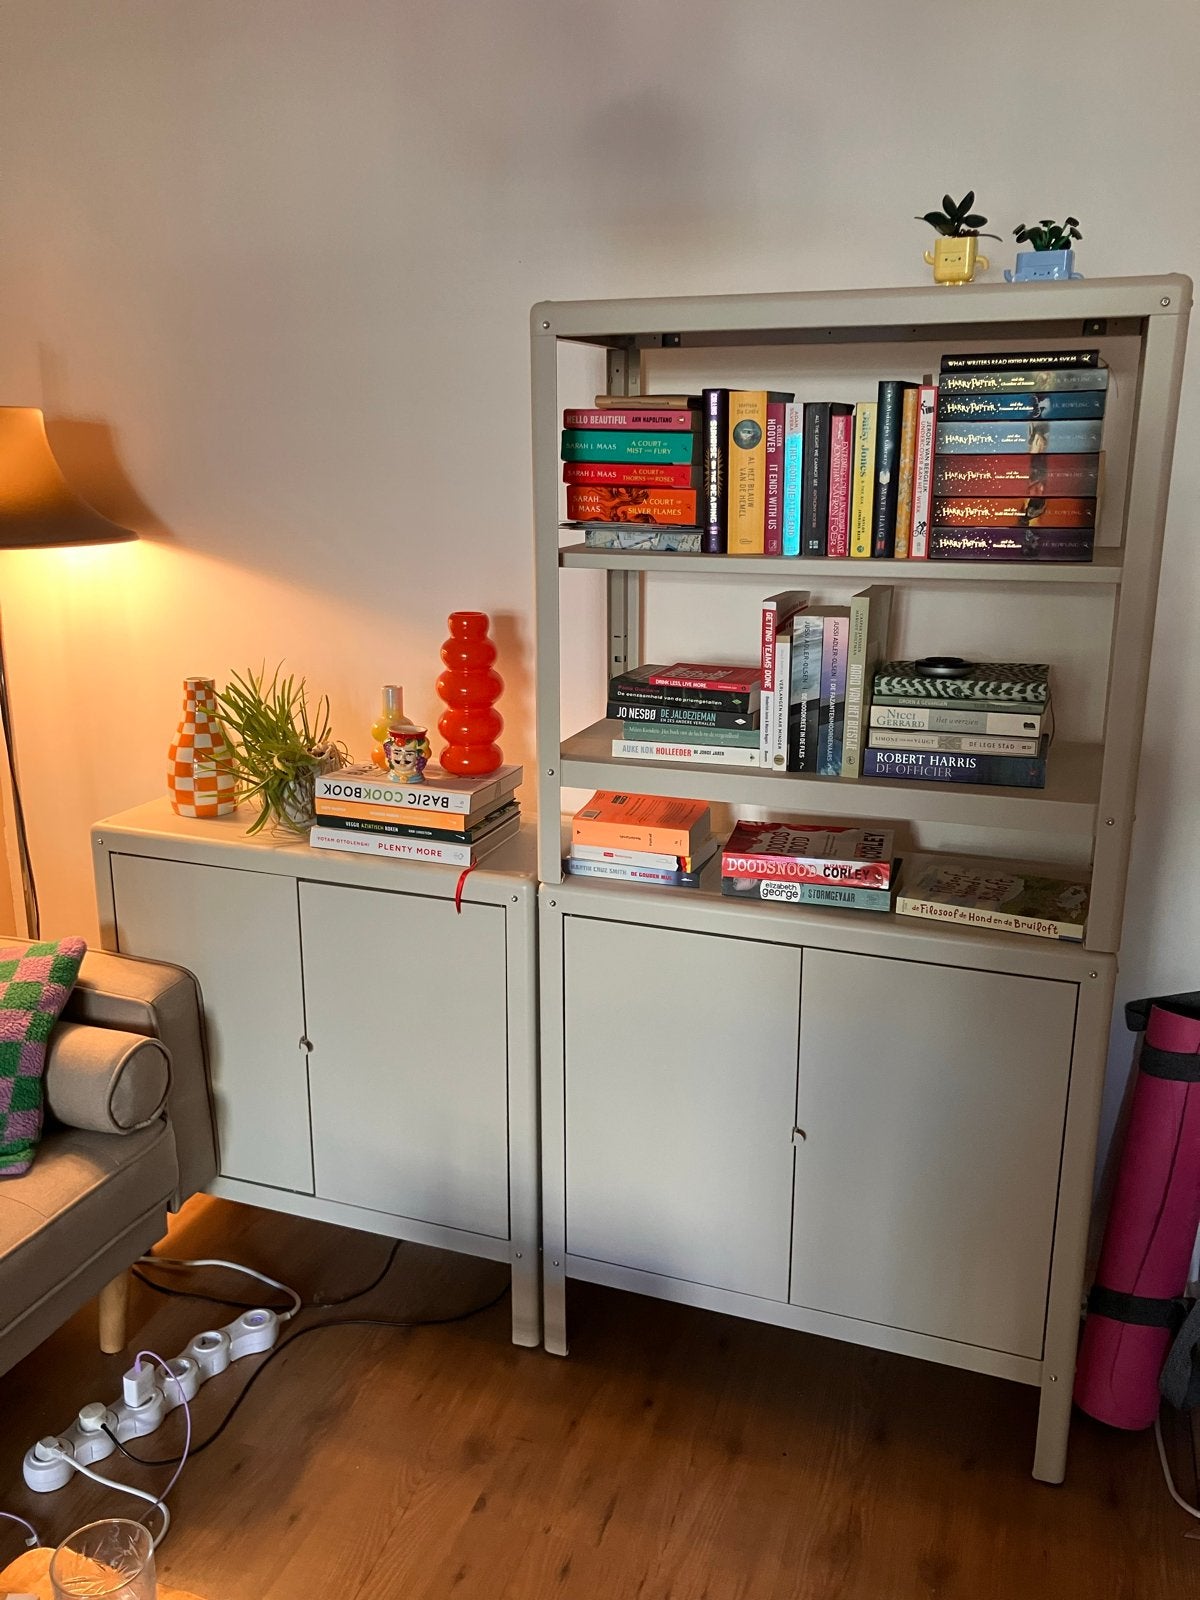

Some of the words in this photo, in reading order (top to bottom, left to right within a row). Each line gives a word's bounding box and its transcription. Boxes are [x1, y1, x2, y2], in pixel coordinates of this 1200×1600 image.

[948, 379, 972, 388] HARRY
[971, 378, 997, 389] POTTER
[947, 404, 970, 413] HARRY
[970, 403, 996, 414] POTTER
[567, 416, 588, 424] HELLO
[590, 416, 627, 424] BEAUTIFUL
[860, 411, 871, 441] Daisy
[767, 419, 776, 453] HOOVER
[945, 435, 969, 443] HARRY
[968, 434, 994, 444] POTTER
[814, 449, 819, 457] WE
[749, 457, 754, 465] AL
[860, 444, 870, 477] Jones
[945, 471, 968, 480] HARRY
[967, 470, 992, 481] POTTER
[739, 484, 746, 493] DE
[768, 474, 777, 495] ENDS
[788, 485, 797, 498] DIE
[573, 495, 599, 503] SARAH
[649, 498, 674, 506] COURT
[578, 505, 601, 513] MAAS
[627, 507, 651, 515] SILVER
[653, 508, 682, 516] FLAMES
[768, 497, 777, 517] WITH
[943, 507, 966, 517] HARRY
[965, 507, 991, 517] POTTER
[768, 520, 776, 530] US
[878, 515, 886, 538] HAIG
[939, 539, 962, 549] HARRY
[962, 538, 988, 549] POTTER
[765, 611, 773, 642] GETTING
[764, 643, 772, 668] TEAMS
[802, 640, 810, 683] ADLER-OLSEN
[831, 637, 839, 677] ADLER-OLSEN
[764, 670, 772, 689] DONE
[850, 664, 862, 685] AARD
[830, 683, 837, 691] DE
[626, 692, 663, 700] eenzaamheid
[682, 697, 723, 706] priemgetallen
[849, 687, 861, 703] VAN
[616, 707, 627, 718] JO
[629, 707, 657, 721] NESBØ
[660, 709, 671, 718] DE
[670, 710, 717, 722] JALOEZIEMAN
[799, 701, 808, 731] NOODKREET
[848, 705, 860, 719] HET
[886, 709, 917, 720] NICCI
[826, 692, 836, 762] FAZANTENMOORDENAARS
[876, 716, 925, 728] GERRARD
[935, 716, 949, 724] Het
[949, 718, 979, 726] weerzien
[846, 720, 859, 750] BEESTJE
[622, 744, 639, 753] AUKE
[640, 745, 654, 754] KOK
[656, 747, 692, 757] HOLLEEDER
[877, 752, 926, 765] ROBERT
[930, 755, 977, 769] HARRIS
[876, 763, 892, 774] DE
[895, 764, 952, 777] OFFICIER
[408, 793, 449, 808] BASIC
[361, 823, 384, 831] AZIATISCH
[336, 839, 370, 847] OTTOLENGHI
[765, 831, 791, 852] DOODS
[860, 832, 885, 859] CORLEY
[378, 842, 413, 854] PLENTY
[416, 844, 443, 858] MORE
[593, 866, 608, 874] CRUZ
[726, 857, 818, 878] DOODSNOOD
[823, 866, 870, 880] CORLEY
[638, 871, 660, 879] GOUDEN
[765, 882, 797, 890] elizabeth
[762, 888, 799, 900] george
[808, 889, 856, 902] STORMGEVAAR
[920, 903, 960, 919] Filosoof
[959, 911, 967, 919] de
[968, 913, 992, 923] Hond
[1004, 919, 1013, 927] de
[1014, 918, 1059, 936] Bruiloft
